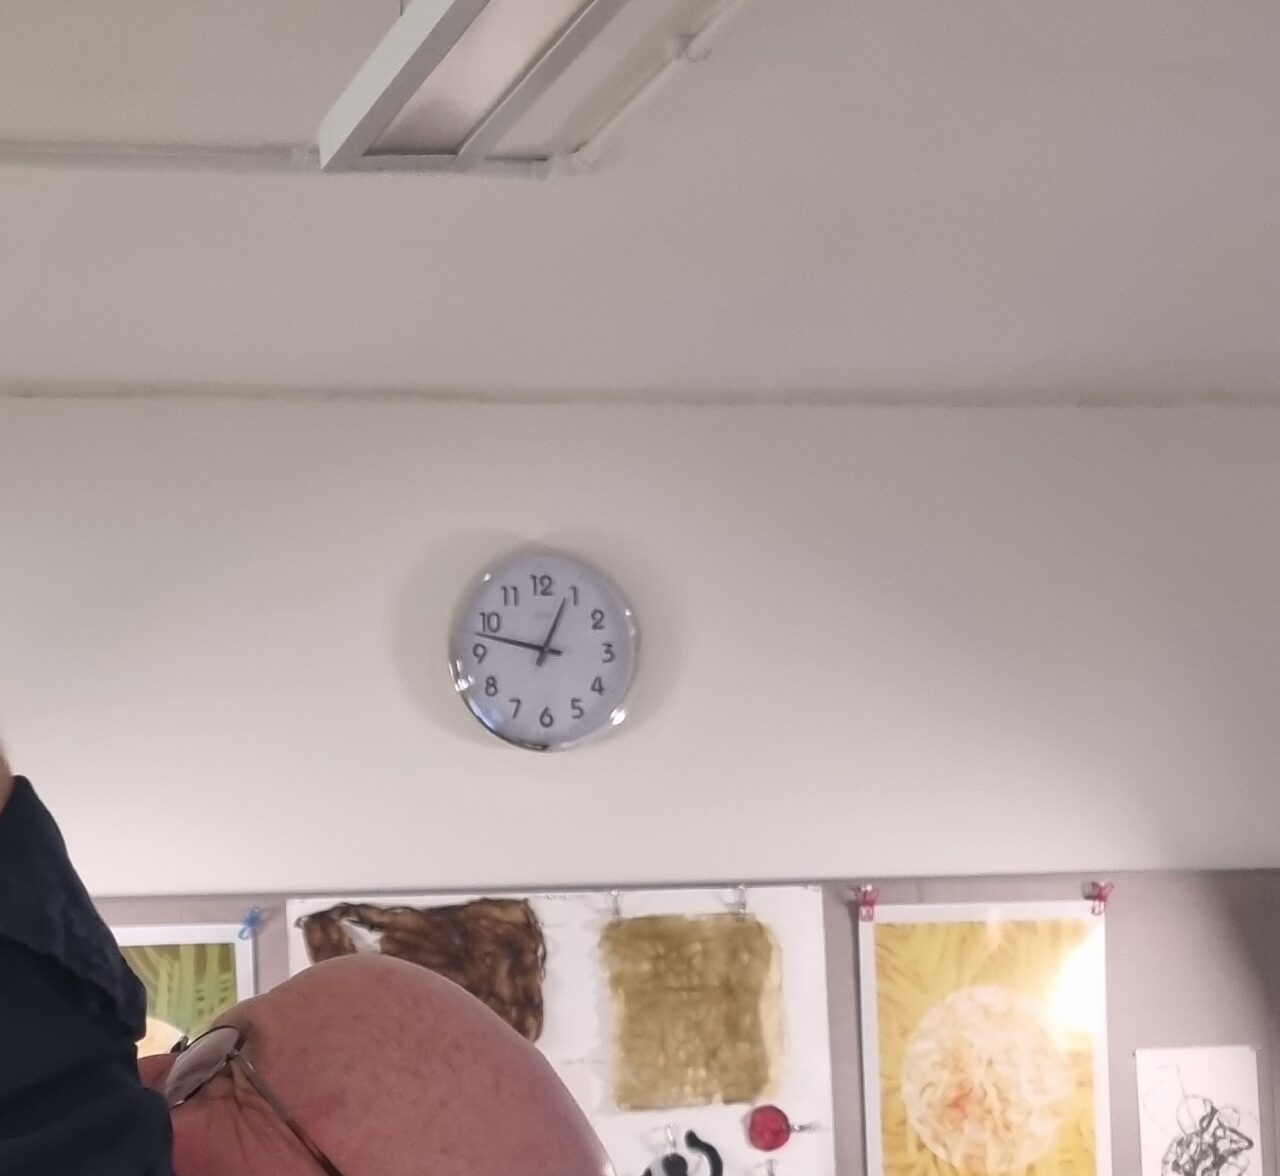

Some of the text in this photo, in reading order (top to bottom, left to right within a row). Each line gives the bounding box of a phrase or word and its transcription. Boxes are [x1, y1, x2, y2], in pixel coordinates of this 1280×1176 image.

[500, 585, 519, 607] 11
[529, 574, 554, 597] 12
[570, 585, 579, 607] 1
[479, 611, 501, 634] 10
[590, 609, 605, 630] 2
[472, 643, 487, 665] 9
[601, 643, 615, 664] 3
[484, 676, 498, 697] 8
[590, 676, 605, 696] 4
[508, 698, 521, 719] 7
[539, 706, 554, 728] 6
[570, 698, 584, 719] 5
